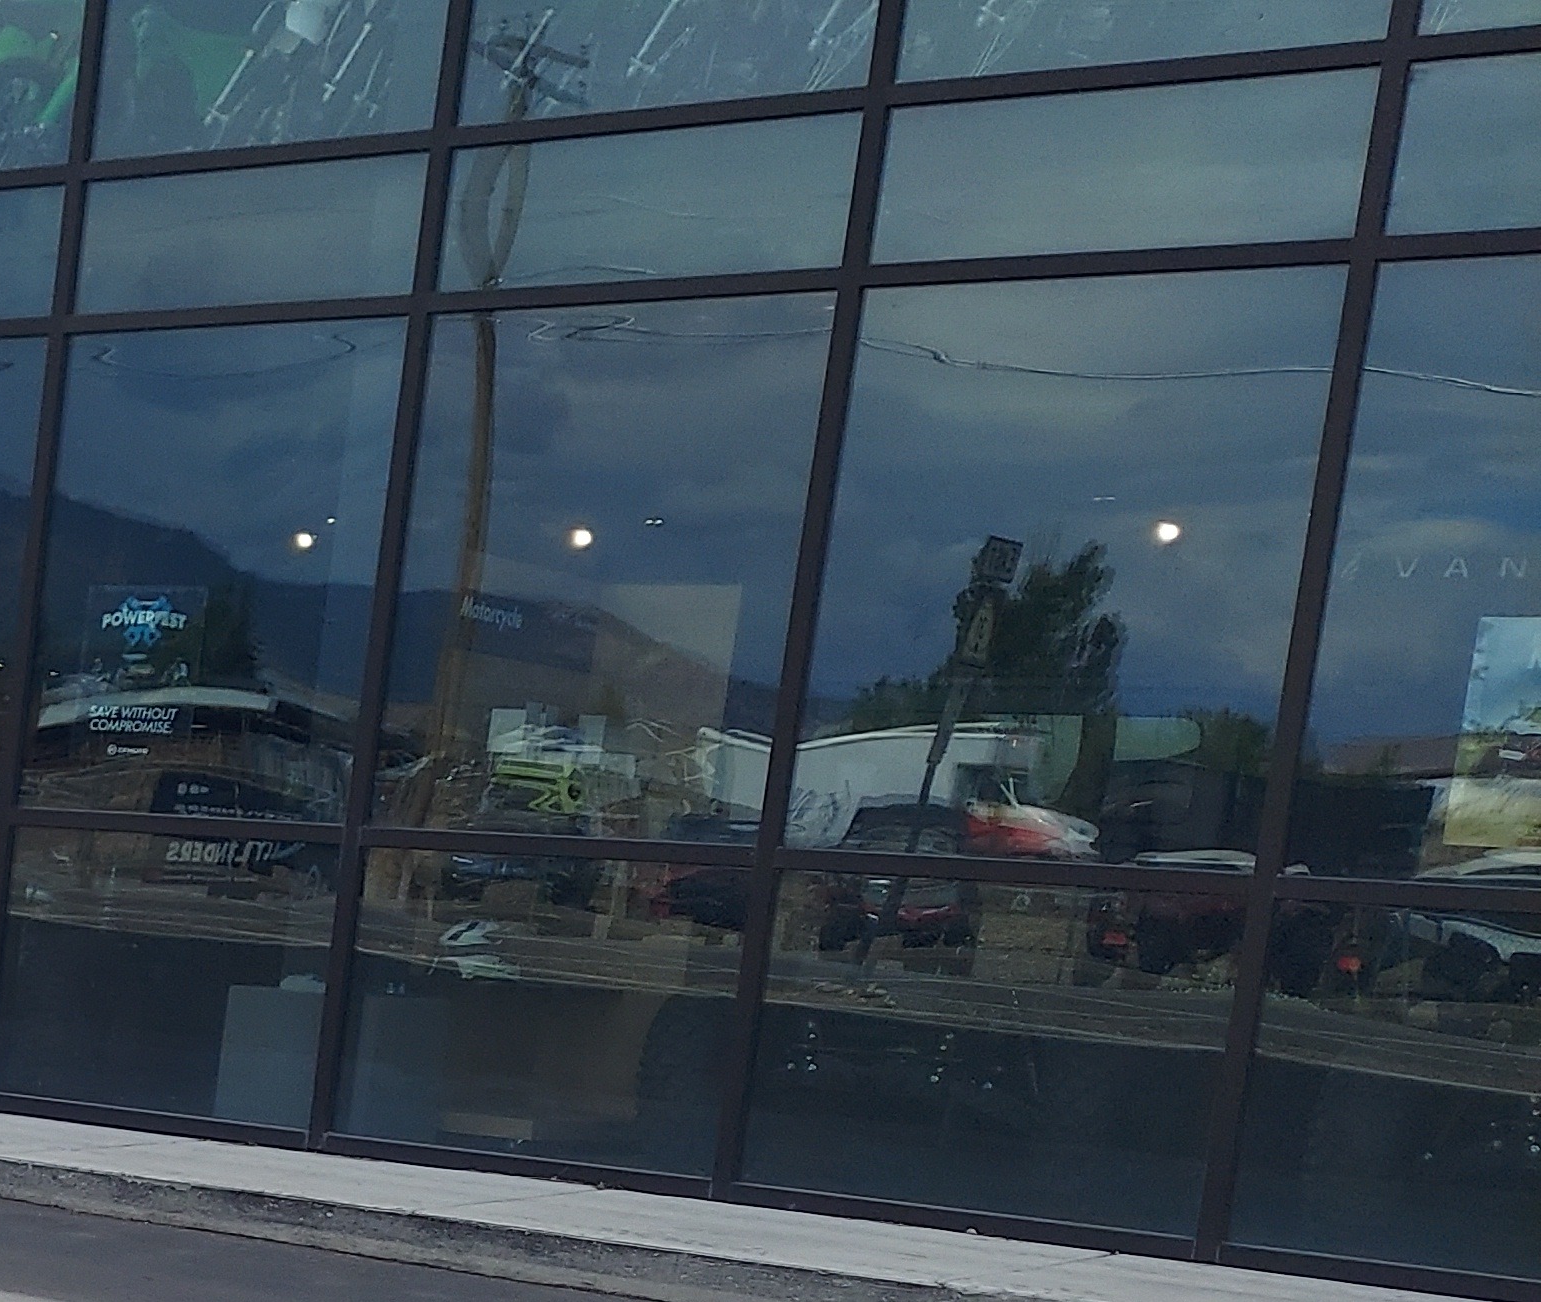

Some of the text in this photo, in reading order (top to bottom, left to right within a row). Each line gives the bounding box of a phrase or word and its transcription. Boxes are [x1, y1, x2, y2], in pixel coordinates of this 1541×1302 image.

[101, 607, 188, 630] POWERFEST
[459, 596, 523, 631] Motorcycle
[88, 705, 179, 721] SAVE WITHOUT
